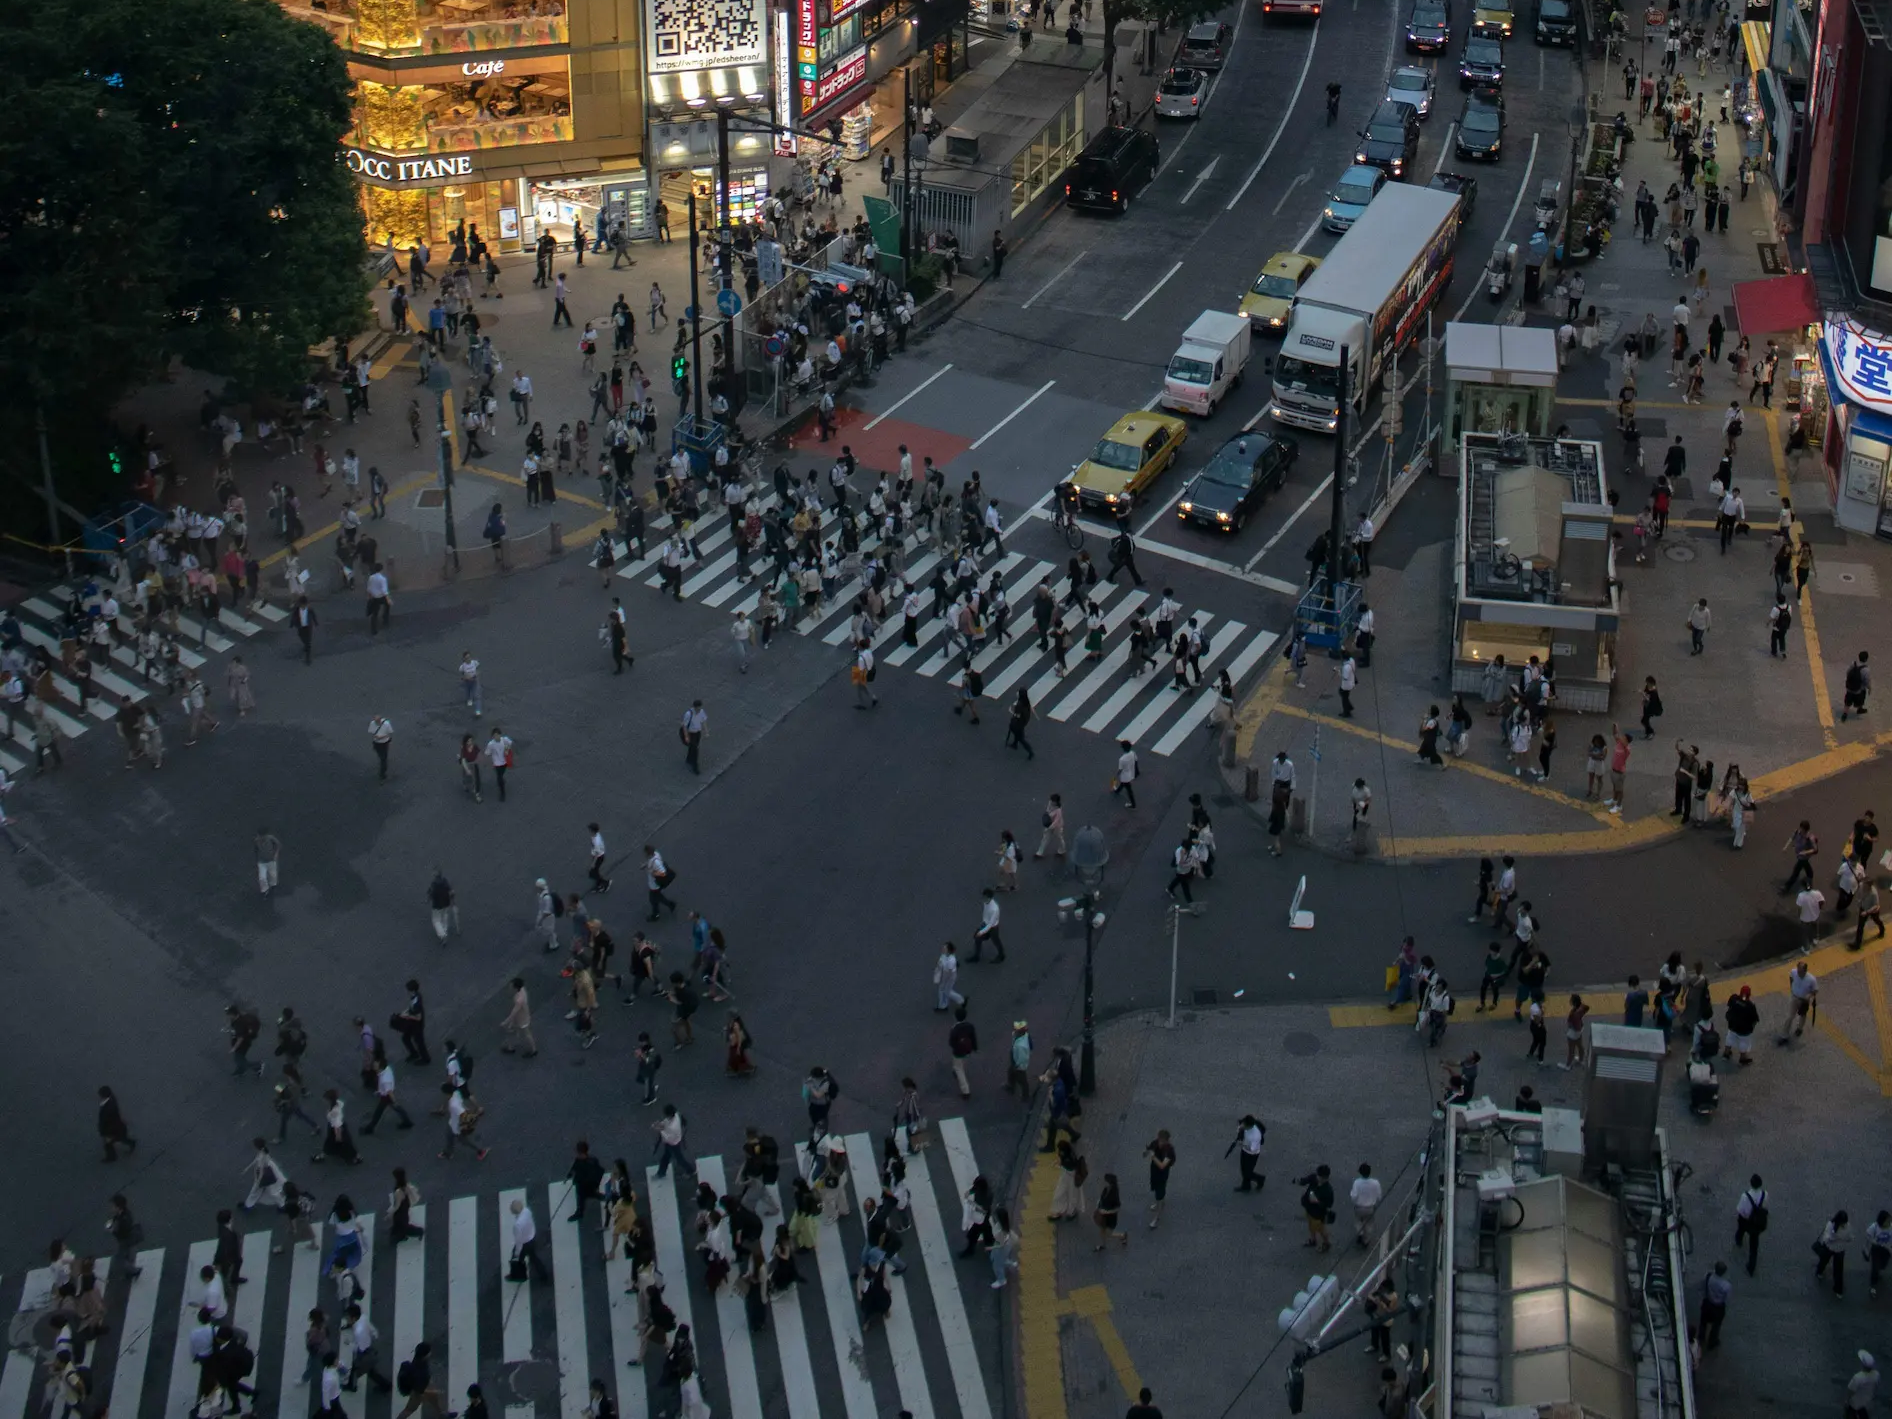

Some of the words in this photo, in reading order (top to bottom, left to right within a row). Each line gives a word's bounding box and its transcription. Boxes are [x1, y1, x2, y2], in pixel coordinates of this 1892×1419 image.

[462, 60, 505, 78] Café
[656, 53, 760, 70] https://wmg.jp/edsheeran/
[819, 66, 855, 101] サンドラッグ
[1301, 339, 1333, 351] STADIUM
[1303, 335, 1334, 346] LIVEDAM
